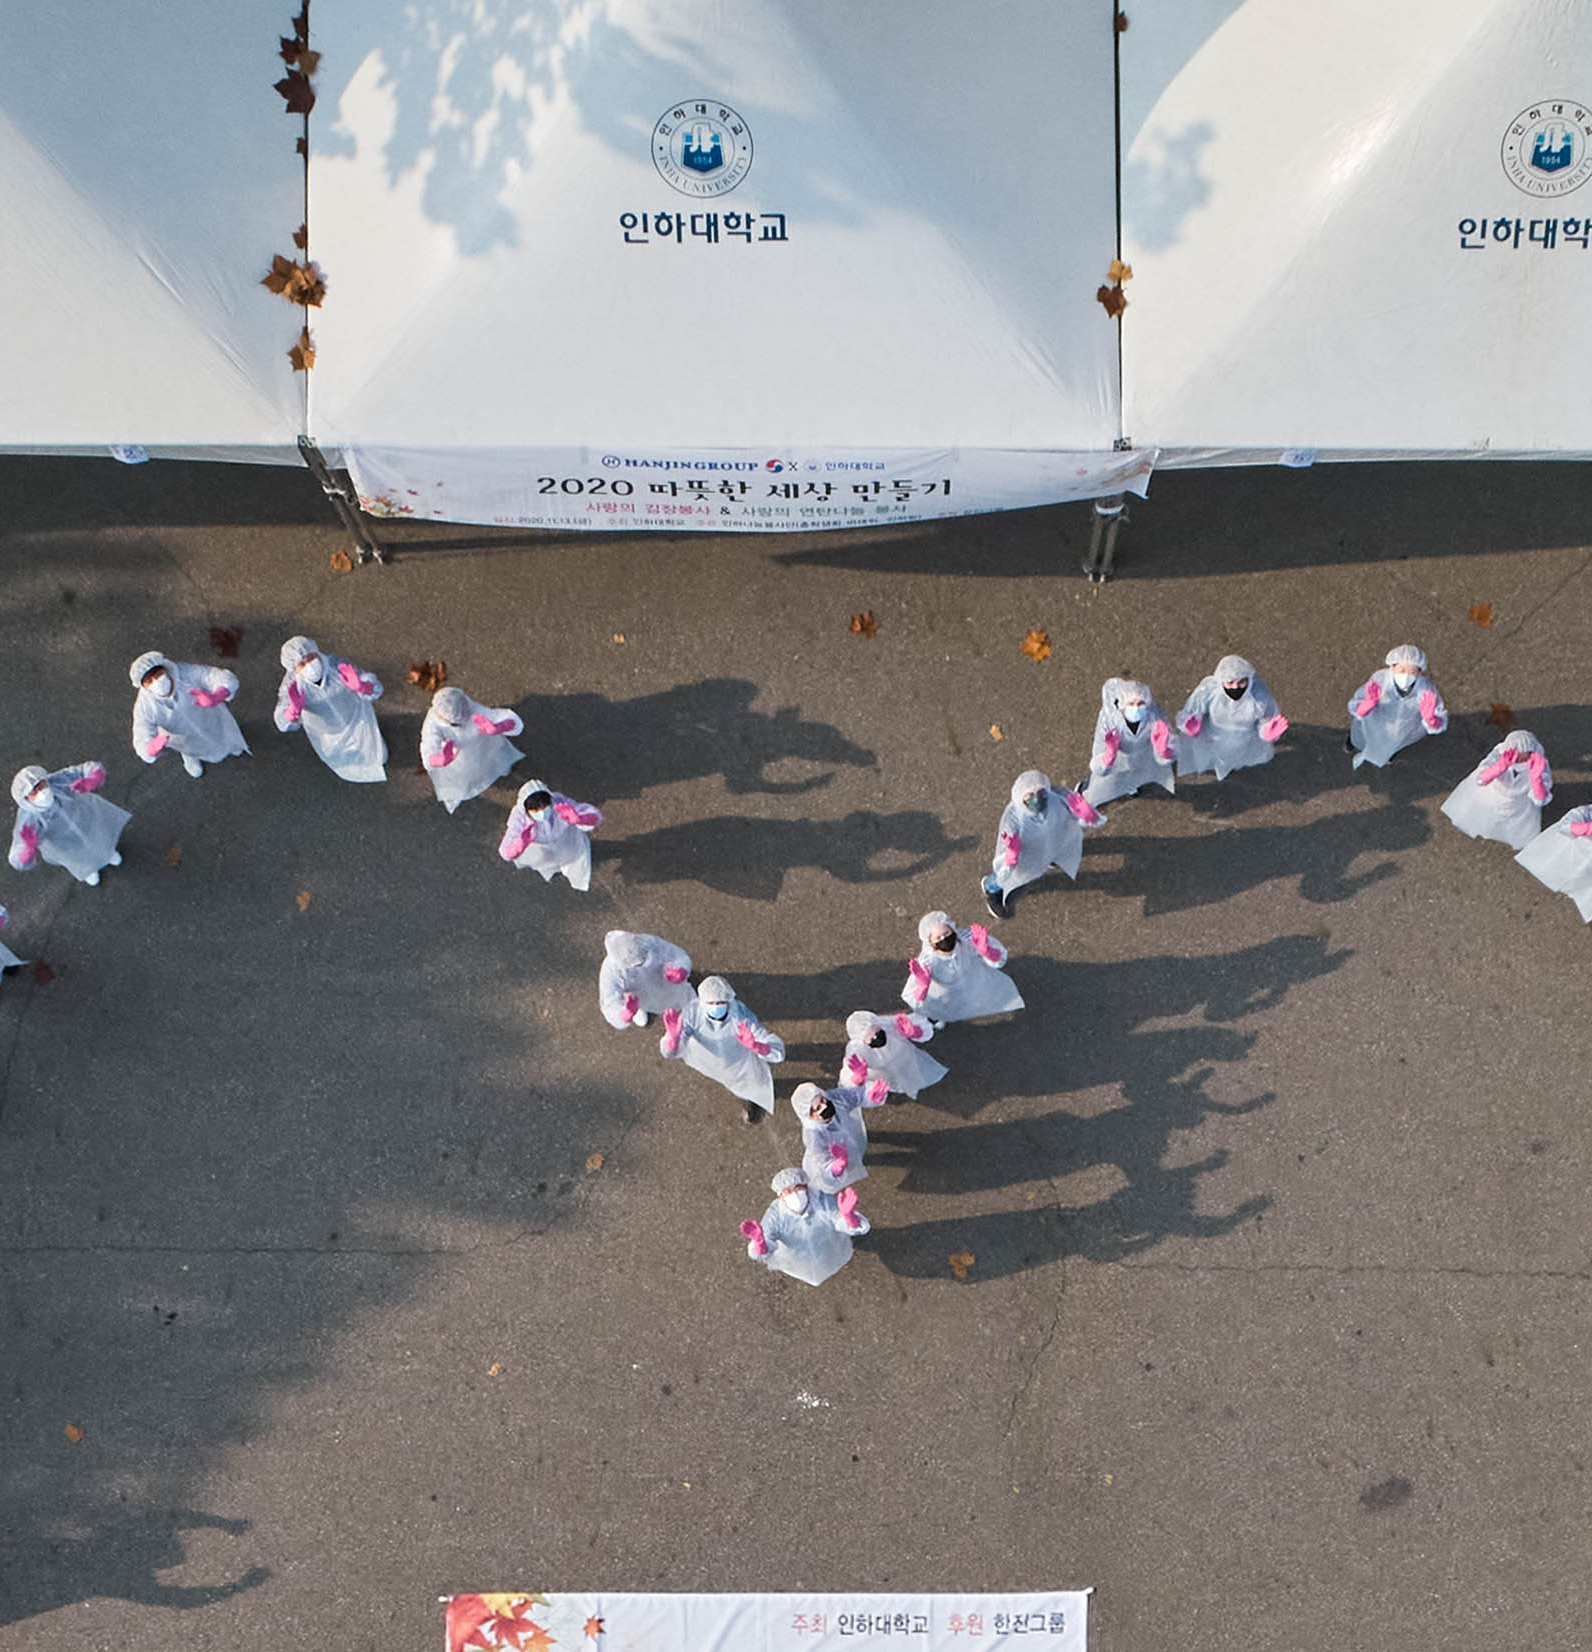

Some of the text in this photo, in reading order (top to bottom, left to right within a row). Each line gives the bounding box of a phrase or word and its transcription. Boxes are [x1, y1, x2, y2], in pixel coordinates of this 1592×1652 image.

[619, 211, 789, 243] 인하대학교
[537, 477, 951, 502] 2020 따뜻한 세상 만들기
[720, 507, 730, 515] &
[791, 1612, 1066, 1635] 주최 인하대학교 후원 한진그룹
